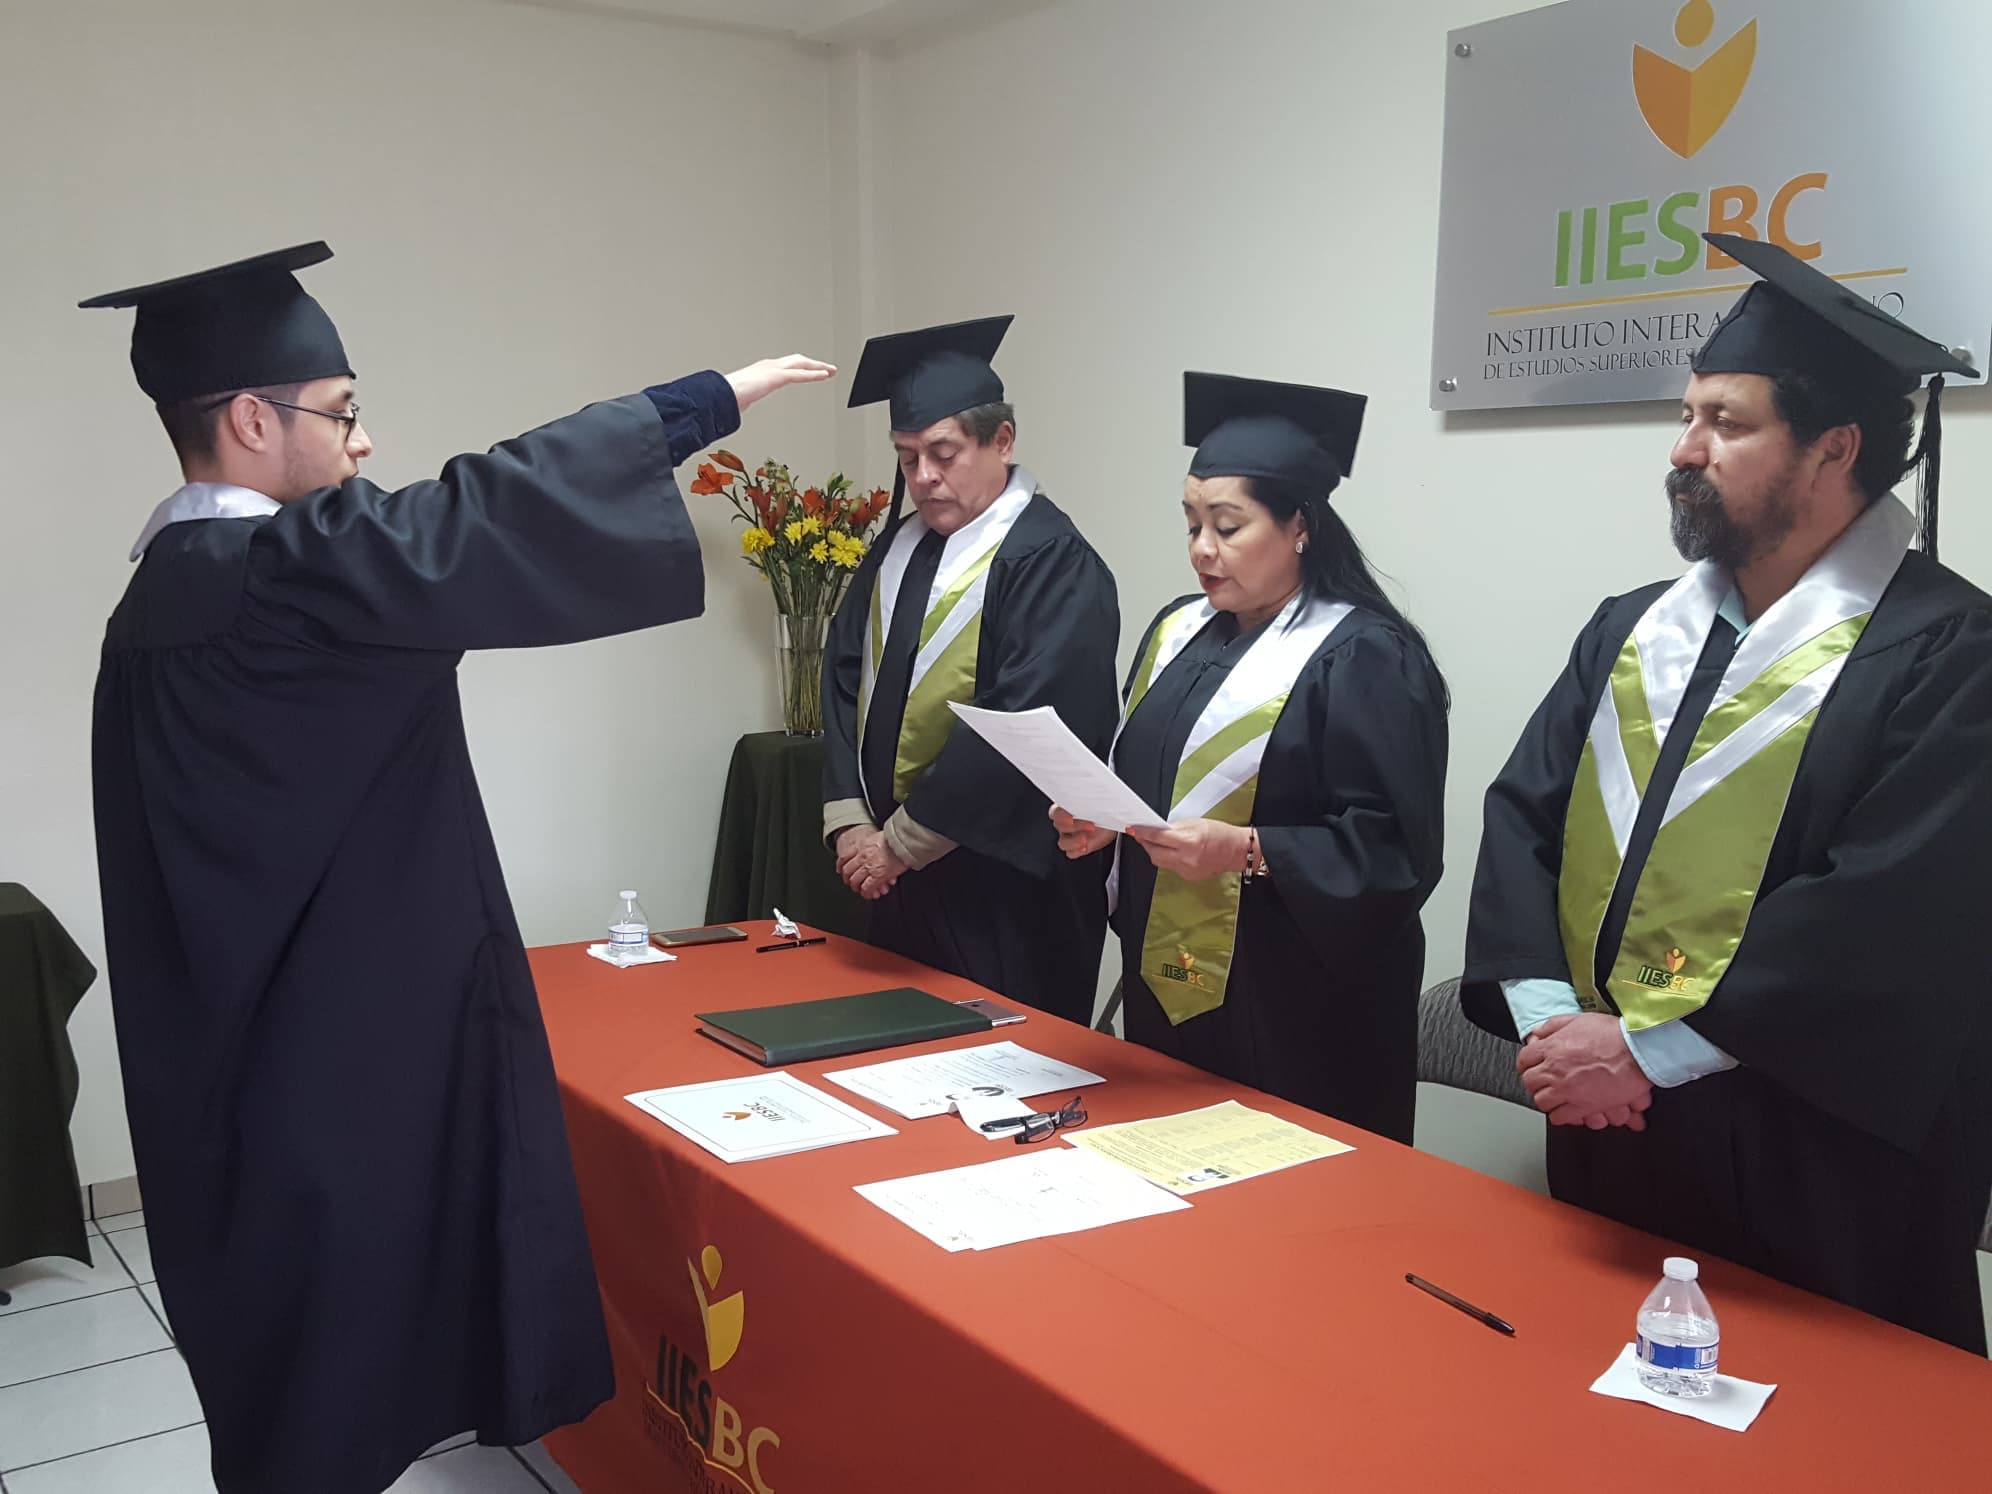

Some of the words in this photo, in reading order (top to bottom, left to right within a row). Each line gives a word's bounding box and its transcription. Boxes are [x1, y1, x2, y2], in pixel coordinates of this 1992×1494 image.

[1553, 172, 1828, 288] IIESBC
[1486, 321, 1615, 356] INSTITUTO
[1484, 362, 1505, 380] DE
[1509, 356, 1585, 378] ESTUDIOS
[1589, 348, 1696, 372] SUPERIORES
[1162, 963, 1205, 986] IIESBC
[1636, 965, 1696, 991] IIESBC
[656, 1333, 781, 1494] IIESBC
